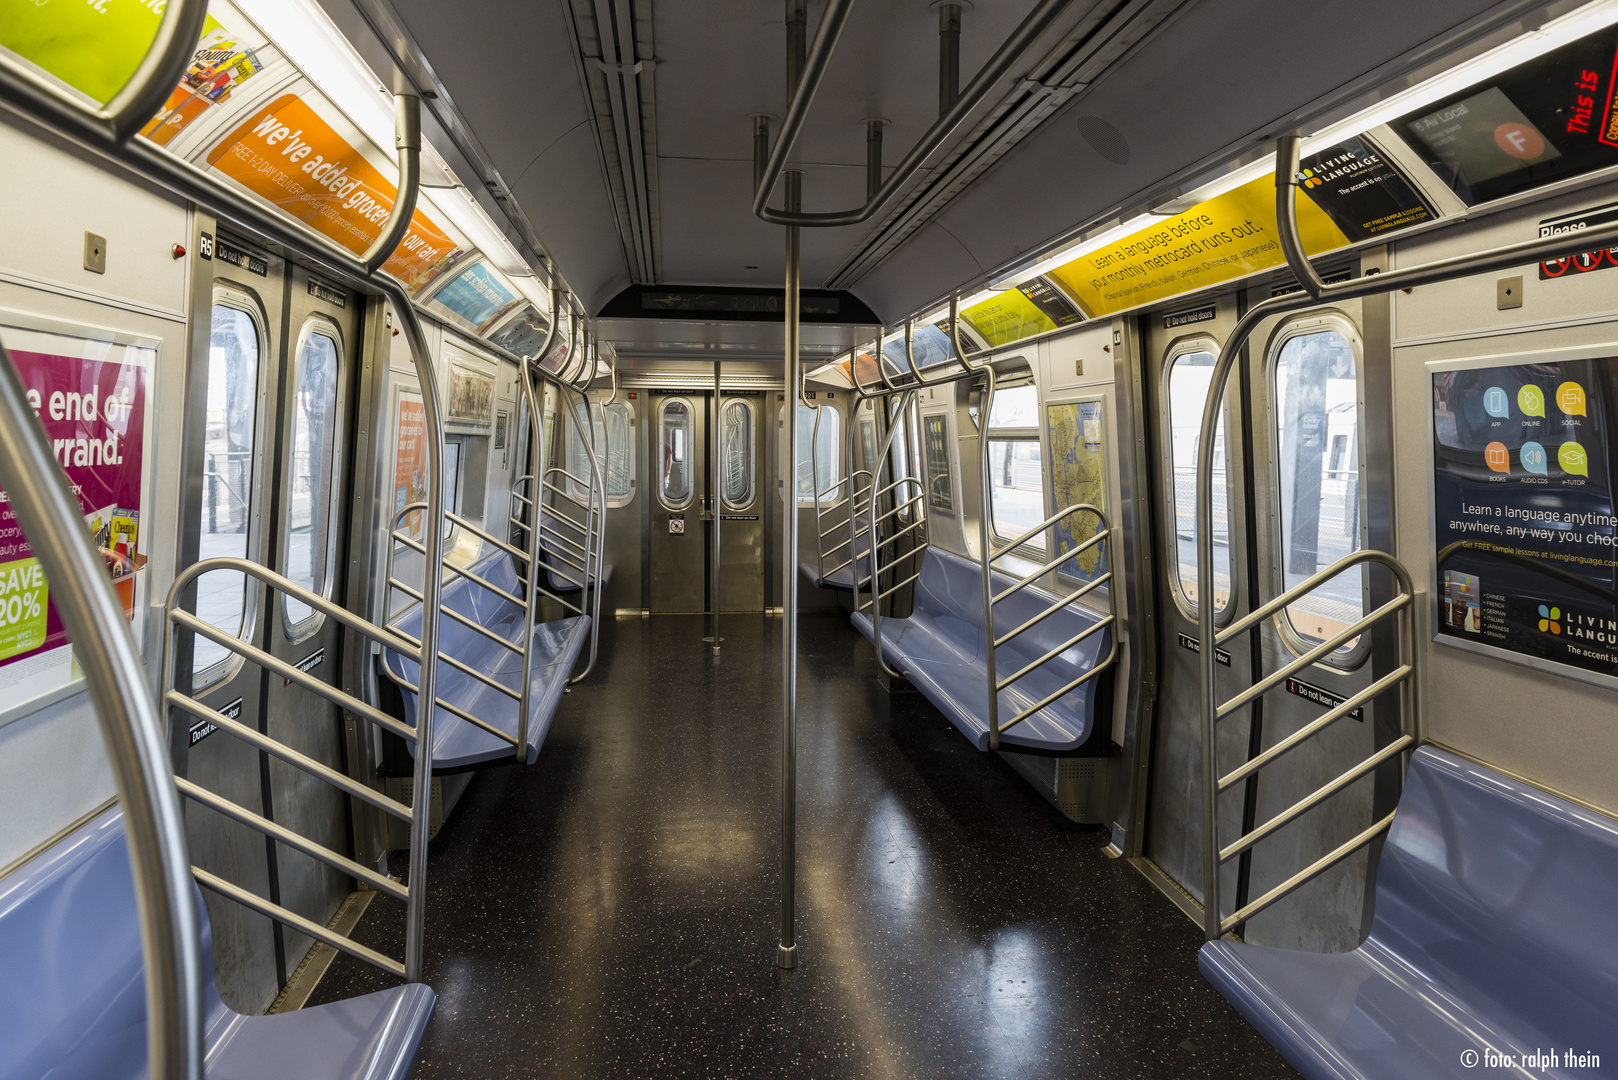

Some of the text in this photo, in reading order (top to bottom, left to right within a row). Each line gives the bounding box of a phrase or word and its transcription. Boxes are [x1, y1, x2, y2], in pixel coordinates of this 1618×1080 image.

[1567, 69, 1598, 133] This is
[1424, 118, 1438, 129] Av
[1438, 103, 1469, 122] Local
[1505, 130, 1527, 152] F
[232, 141, 254, 161] FREE
[258, 161, 278, 177] DAY
[252, 114, 362, 199] we've added
[1313, 152, 1356, 174] LIVING
[1322, 155, 1380, 182] LANGUAGE
[1338, 188, 1351, 196] The
[1350, 181, 1369, 192] accent
[1362, 222, 1373, 230] GET
[1372, 218, 1384, 227] FREE
[1383, 211, 1402, 222] SAMPLE
[200, 236, 212, 256] R5
[403, 235, 425, 251] our
[1088, 213, 1213, 270] Learn a language before
[219, 246, 227, 258] Do
[228, 252, 237, 262] not
[1088, 220, 1264, 291] your monthly metrocard runs out.
[1201, 257, 1231, 271] Chinese,
[1230, 253, 1240, 262] or
[1239, 240, 1279, 259] Japanese)
[1172, 316, 1179, 325] Do
[1179, 314, 1187, 323] not
[49, 385, 98, 421] end
[104, 387, 128, 420] of
[53, 431, 122, 467] rrand.
[1462, 502, 1492, 515] Learn
[1495, 507, 1502, 517] a
[1505, 505, 1560, 524] language
[1449, 520, 1503, 536] anywhere,
[1506, 525, 1527, 539] any
[1530, 528, 1555, 542] way
[1558, 531, 1582, 543] you
[1462, 541, 1473, 549] Get
[1474, 542, 1490, 550] FREE
[1492, 545, 1514, 556] sample
[1516, 547, 1540, 557] lessons
[1486, 601, 1505, 609] FRENCH
[1486, 608, 1506, 617] GERMAN
[1486, 616, 1504, 624] ITALIAN
[1487, 623, 1510, 633] JAPANESE
[1567, 612, 1617, 631] LIVIN
[1487, 630, 1505, 639] SPANISH
[1567, 626, 1617, 644] LANGU
[1567, 644, 1581, 655] The
[1583, 650, 1609, 662] accent
[1298, 685, 1307, 696] Do
[1308, 690, 1318, 701] not
[1319, 694, 1332, 707] lean
[192, 731, 201, 743] Do
[200, 724, 210, 738] not
